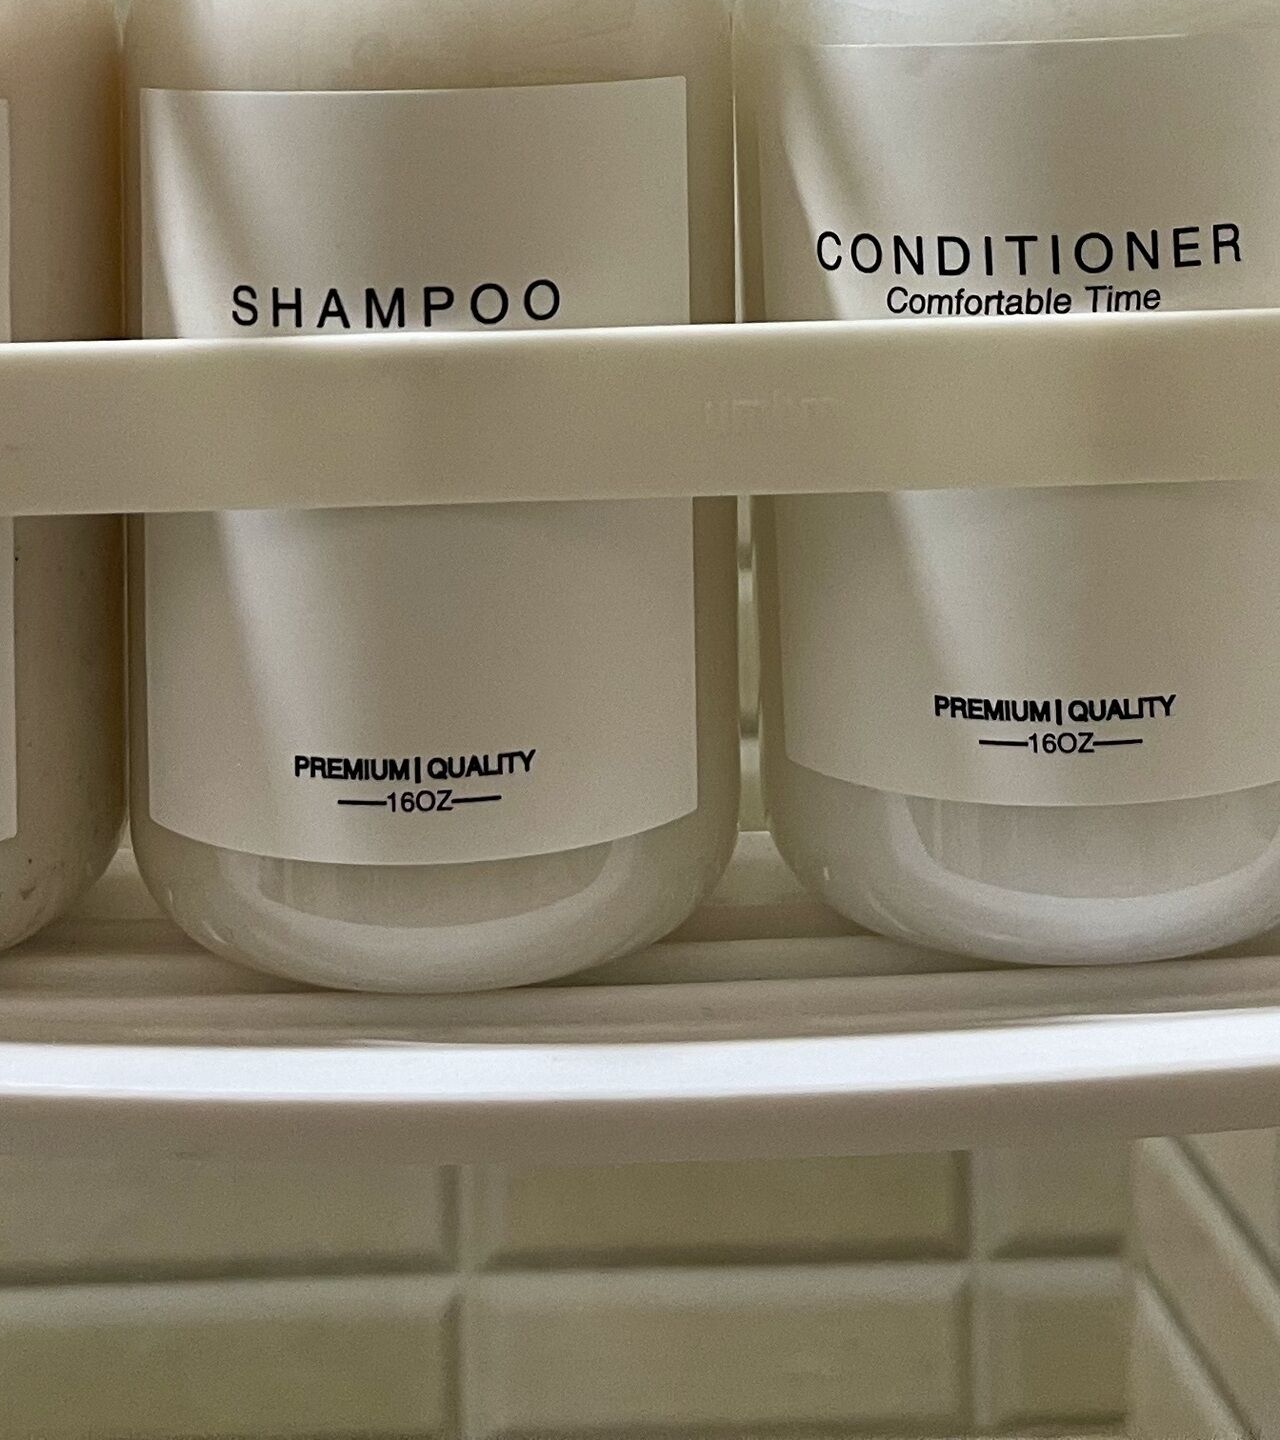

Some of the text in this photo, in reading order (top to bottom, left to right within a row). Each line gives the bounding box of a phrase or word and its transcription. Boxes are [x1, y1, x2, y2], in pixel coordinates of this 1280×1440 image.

[816, 223, 1243, 276] CONDITIONER
[232, 279, 561, 329] SHAMPOO
[886, 285, 1162, 316] Comfortable Time
[1028, 732, 1095, 753] 16OZ
[386, 789, 453, 812] 16OZ
